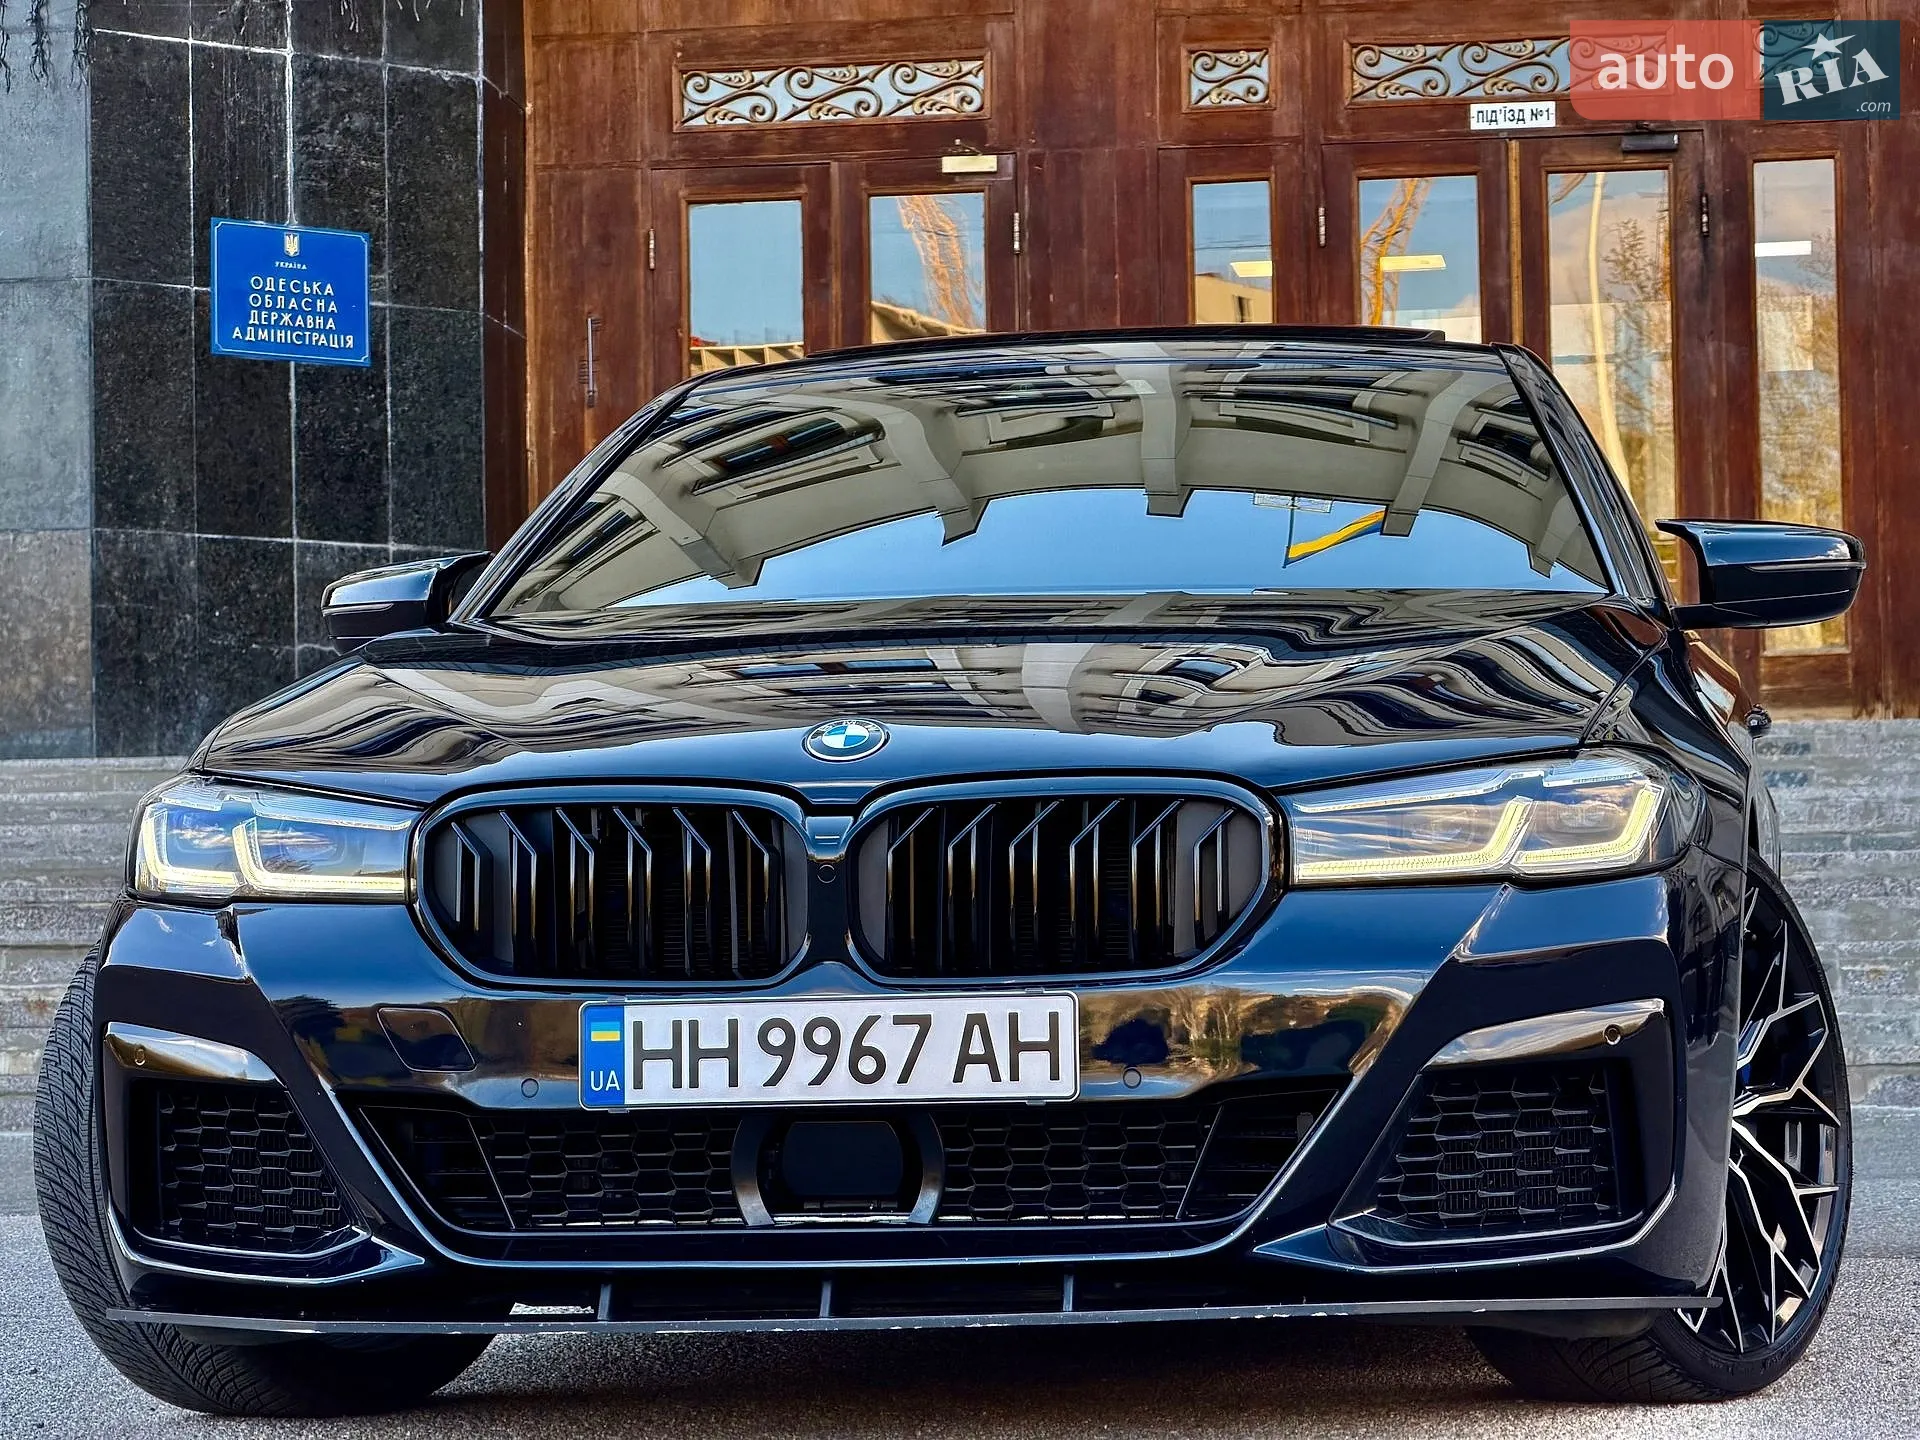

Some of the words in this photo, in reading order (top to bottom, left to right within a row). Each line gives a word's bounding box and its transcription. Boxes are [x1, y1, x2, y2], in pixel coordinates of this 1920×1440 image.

[250, 276, 334, 296] ОДЕСЬКА
[249, 293, 338, 313] ОБЛАСНА
[248, 310, 336, 330] ДЕРЖАВНА
[232, 327, 354, 348] АДМІНІСТРАЦІЯ
[632, 1018, 739, 1089] HH
[757, 1013, 933, 1087] 9967
[952, 1010, 1061, 1083] AH
[589, 1069, 621, 1092] UA
